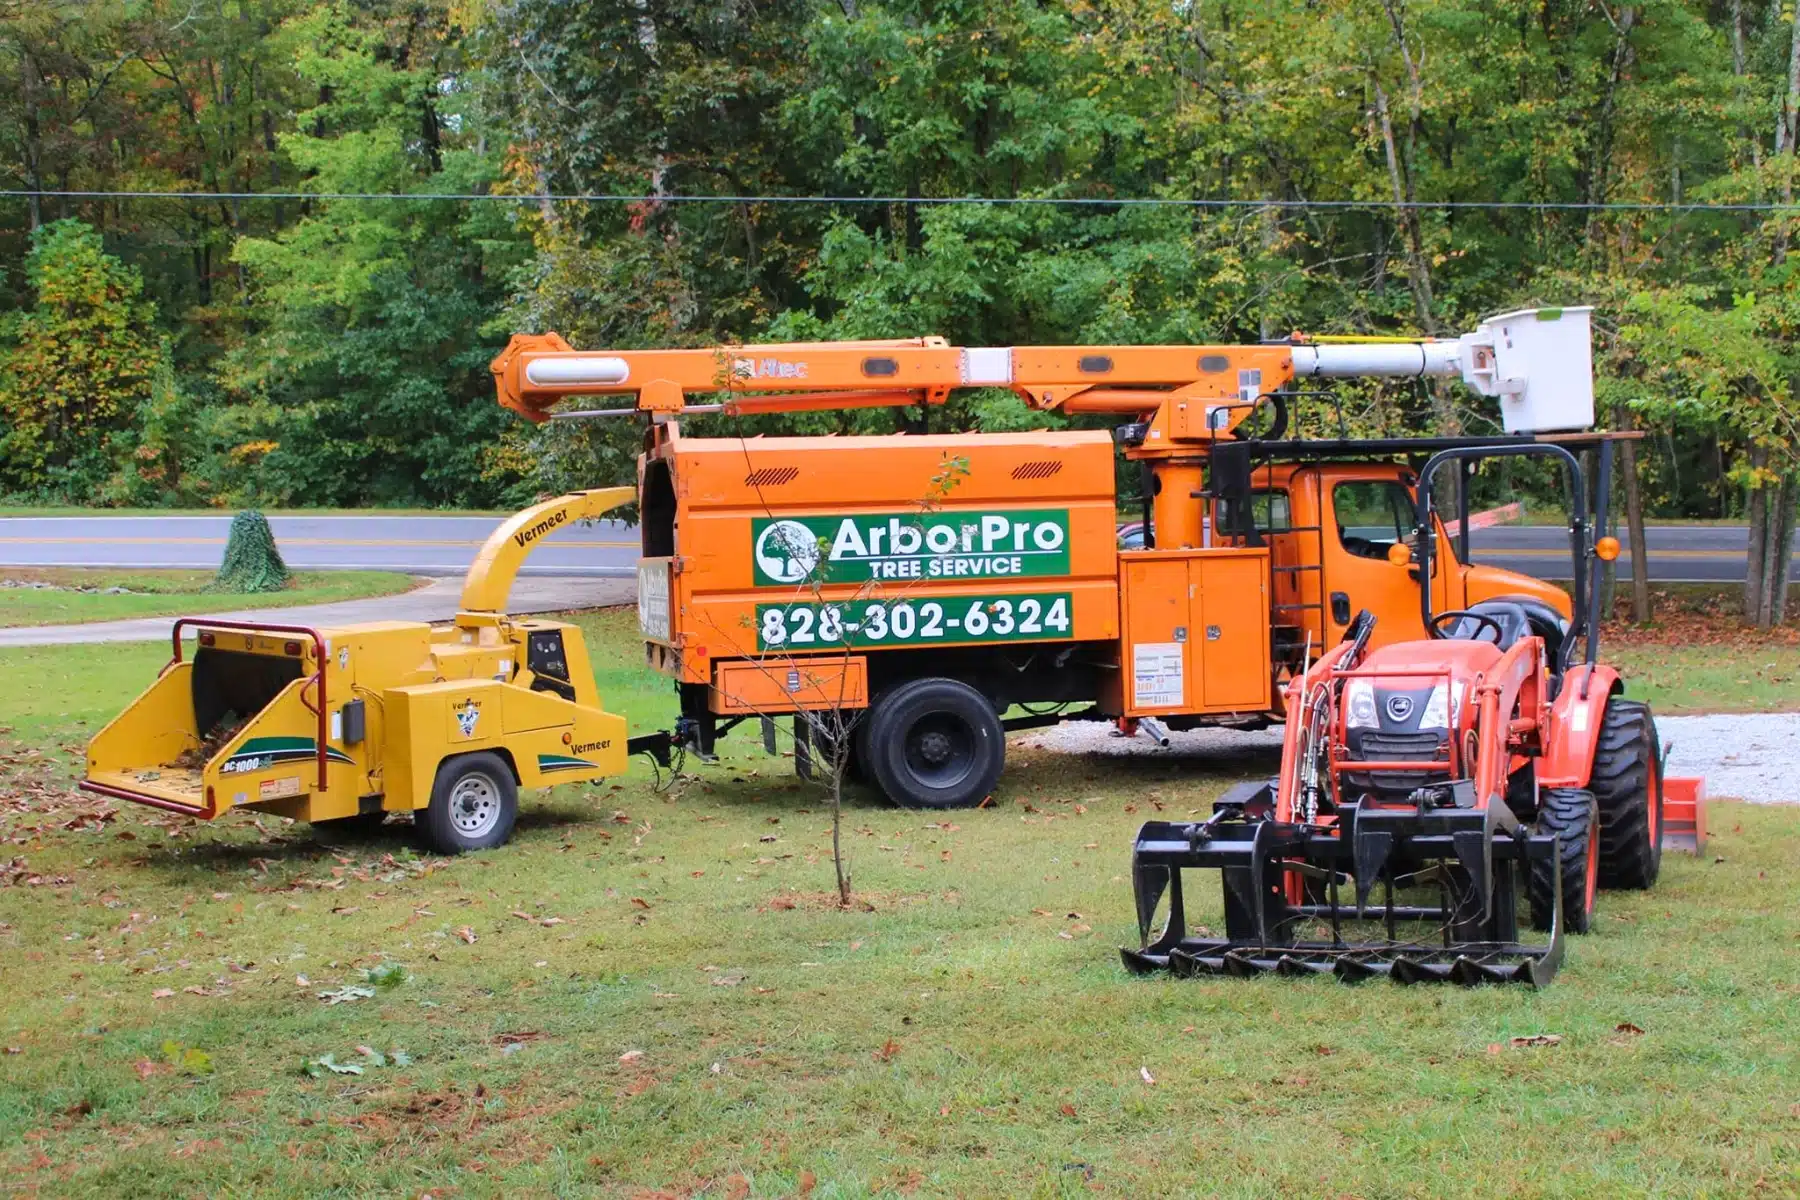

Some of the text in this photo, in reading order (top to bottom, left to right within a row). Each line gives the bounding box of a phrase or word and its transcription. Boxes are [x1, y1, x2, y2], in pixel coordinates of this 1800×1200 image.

[758, 358, 809, 379] Altec
[514, 508, 568, 548] Vermeer
[830, 515, 1065, 557] ArborPro
[868, 556, 1022, 579] TREE SERVICE
[761, 598, 1070, 645] 828-302-6324
[570, 740, 611, 756] Vermeer
